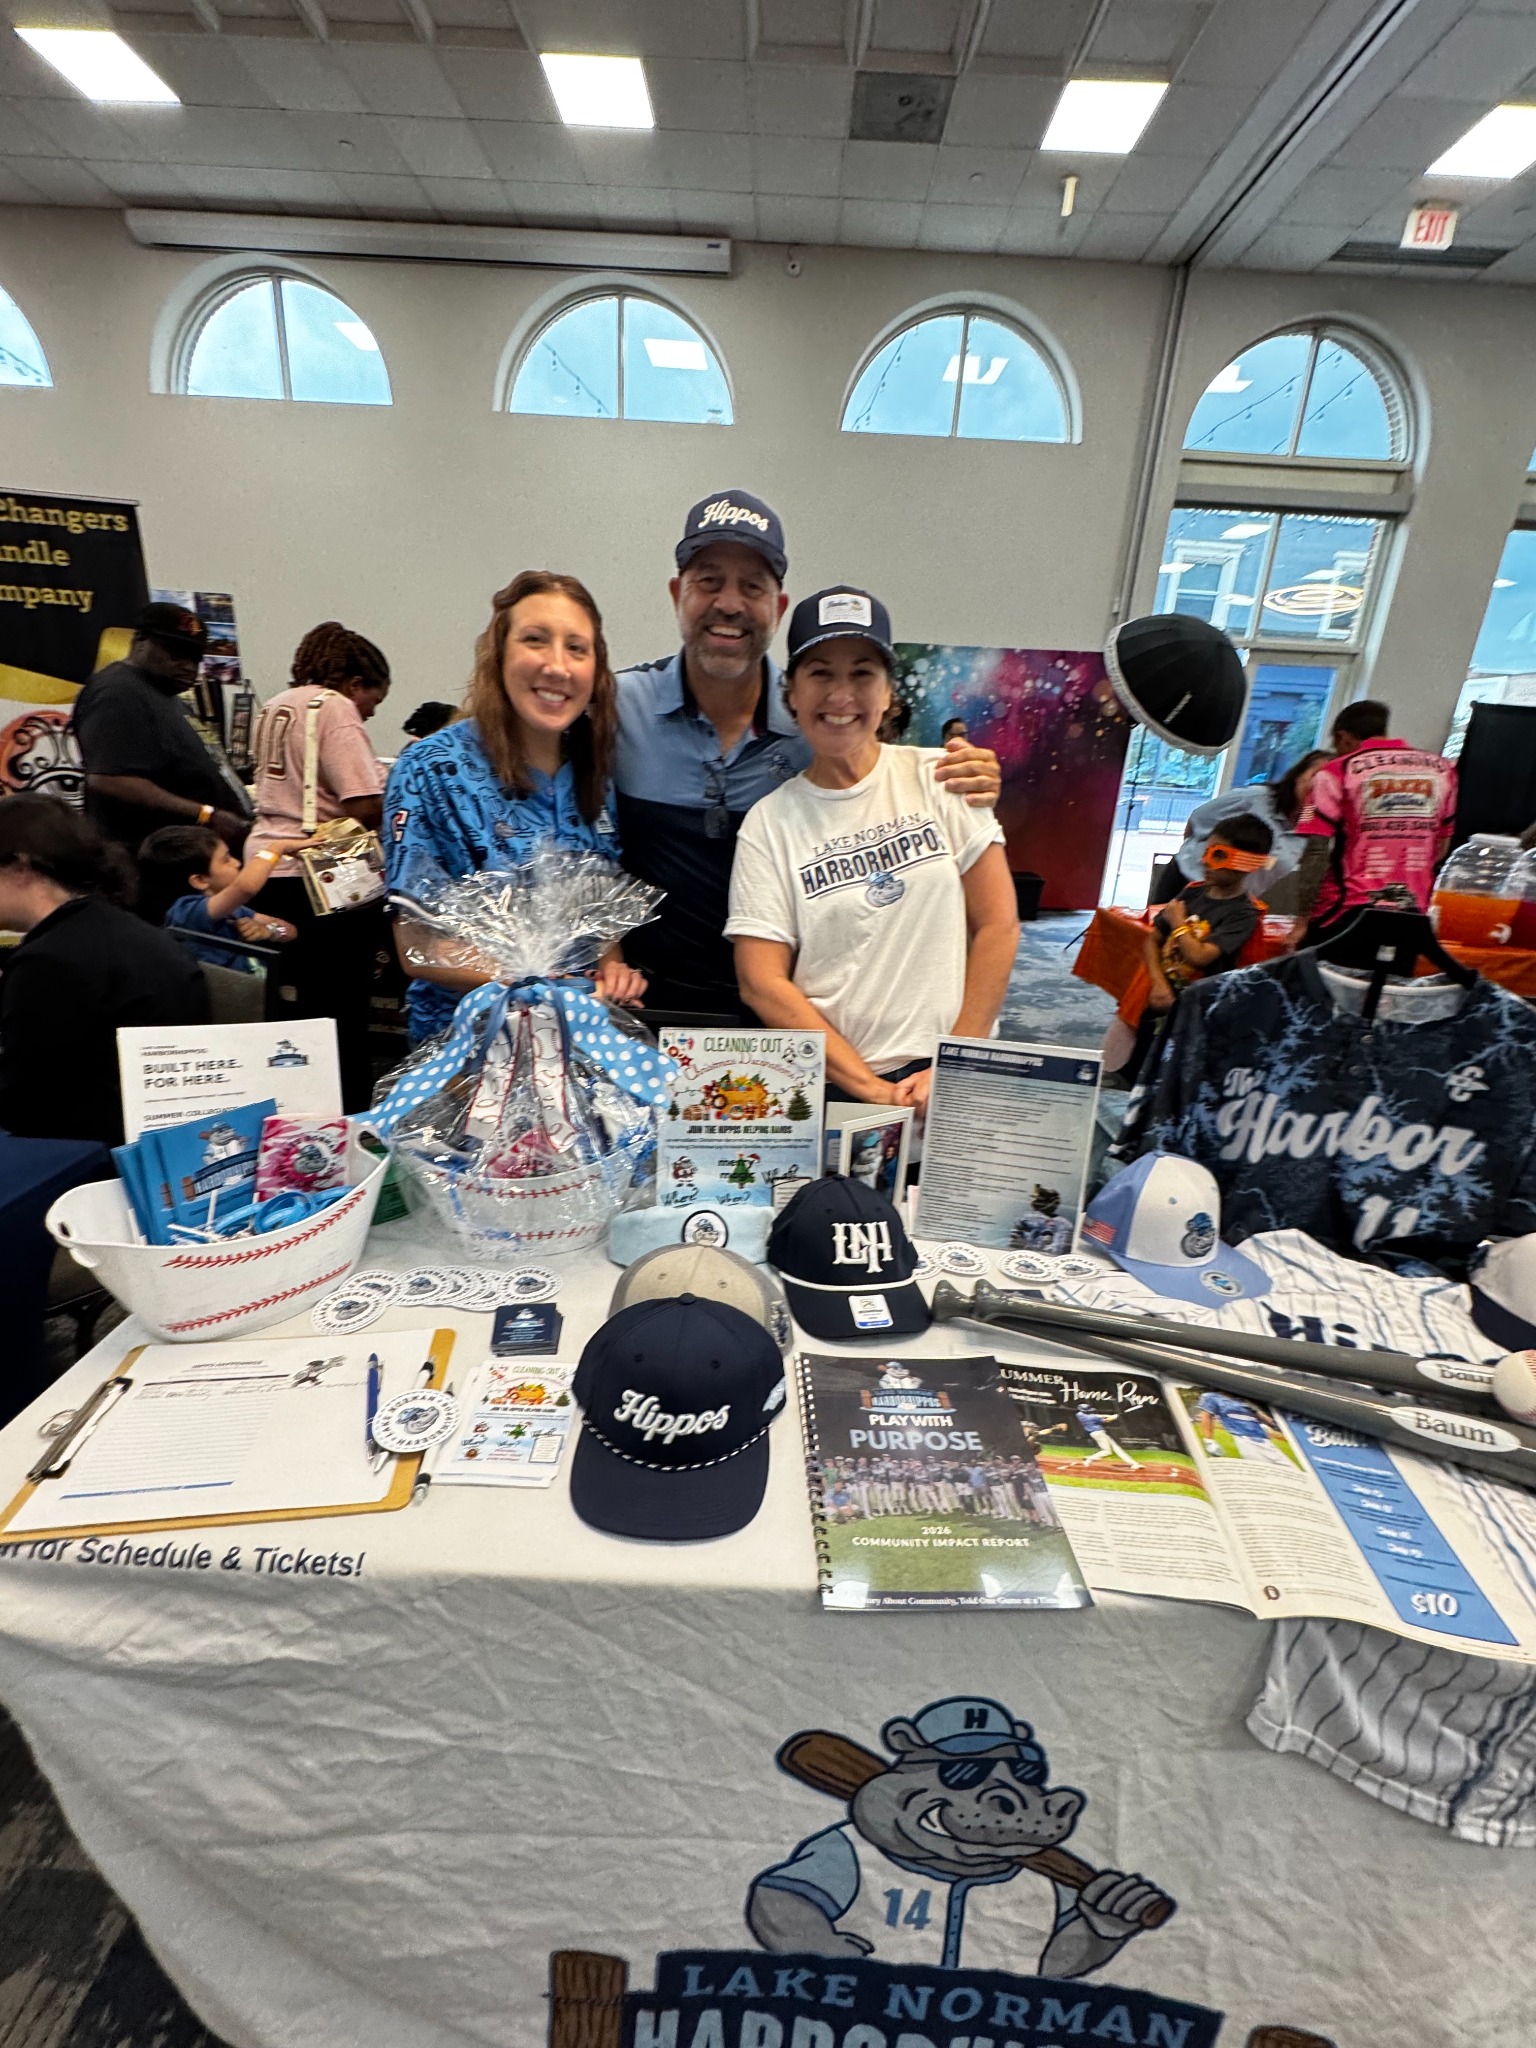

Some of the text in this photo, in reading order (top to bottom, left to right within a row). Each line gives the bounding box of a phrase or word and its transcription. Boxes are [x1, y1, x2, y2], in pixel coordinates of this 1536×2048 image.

[1413, 210, 1451, 243] EXIT
[697, 499, 769, 532] Hippos
[812, 812, 922, 858] LAKE NORMAN
[703, 1037, 783, 1053] CLEANING OUT
[143, 1058, 243, 1075] BUILT HERE.
[144, 1073, 231, 1089] FOR HERE.
[1216, 1091, 1487, 1177] Harbor
[1000, 1368, 1064, 1385] UMMER
[1059, 1381, 1112, 1403] Home
[613, 1389, 731, 1445] Hippos
[869, 1414, 954, 1427] PLAY WITH
[1415, 1411, 1498, 1445] Baum
[849, 1428, 985, 1451] PURPOSE
[851, 1537, 1030, 1548] COMMUNITY IMPACT REPORT
[921, 1526, 952, 1536] 2026
[76, 1536, 212, 1571] Schedule
[220, 1549, 242, 1571] &
[251, 1547, 366, 1578] Tickets!
[1411, 1592, 1459, 1618] $10
[964, 1707, 989, 1730] H
[882, 1888, 932, 1931] 14
[682, 1964, 859, 2008] LAKE
[882, 1983, 1197, 2048] NORMAN
